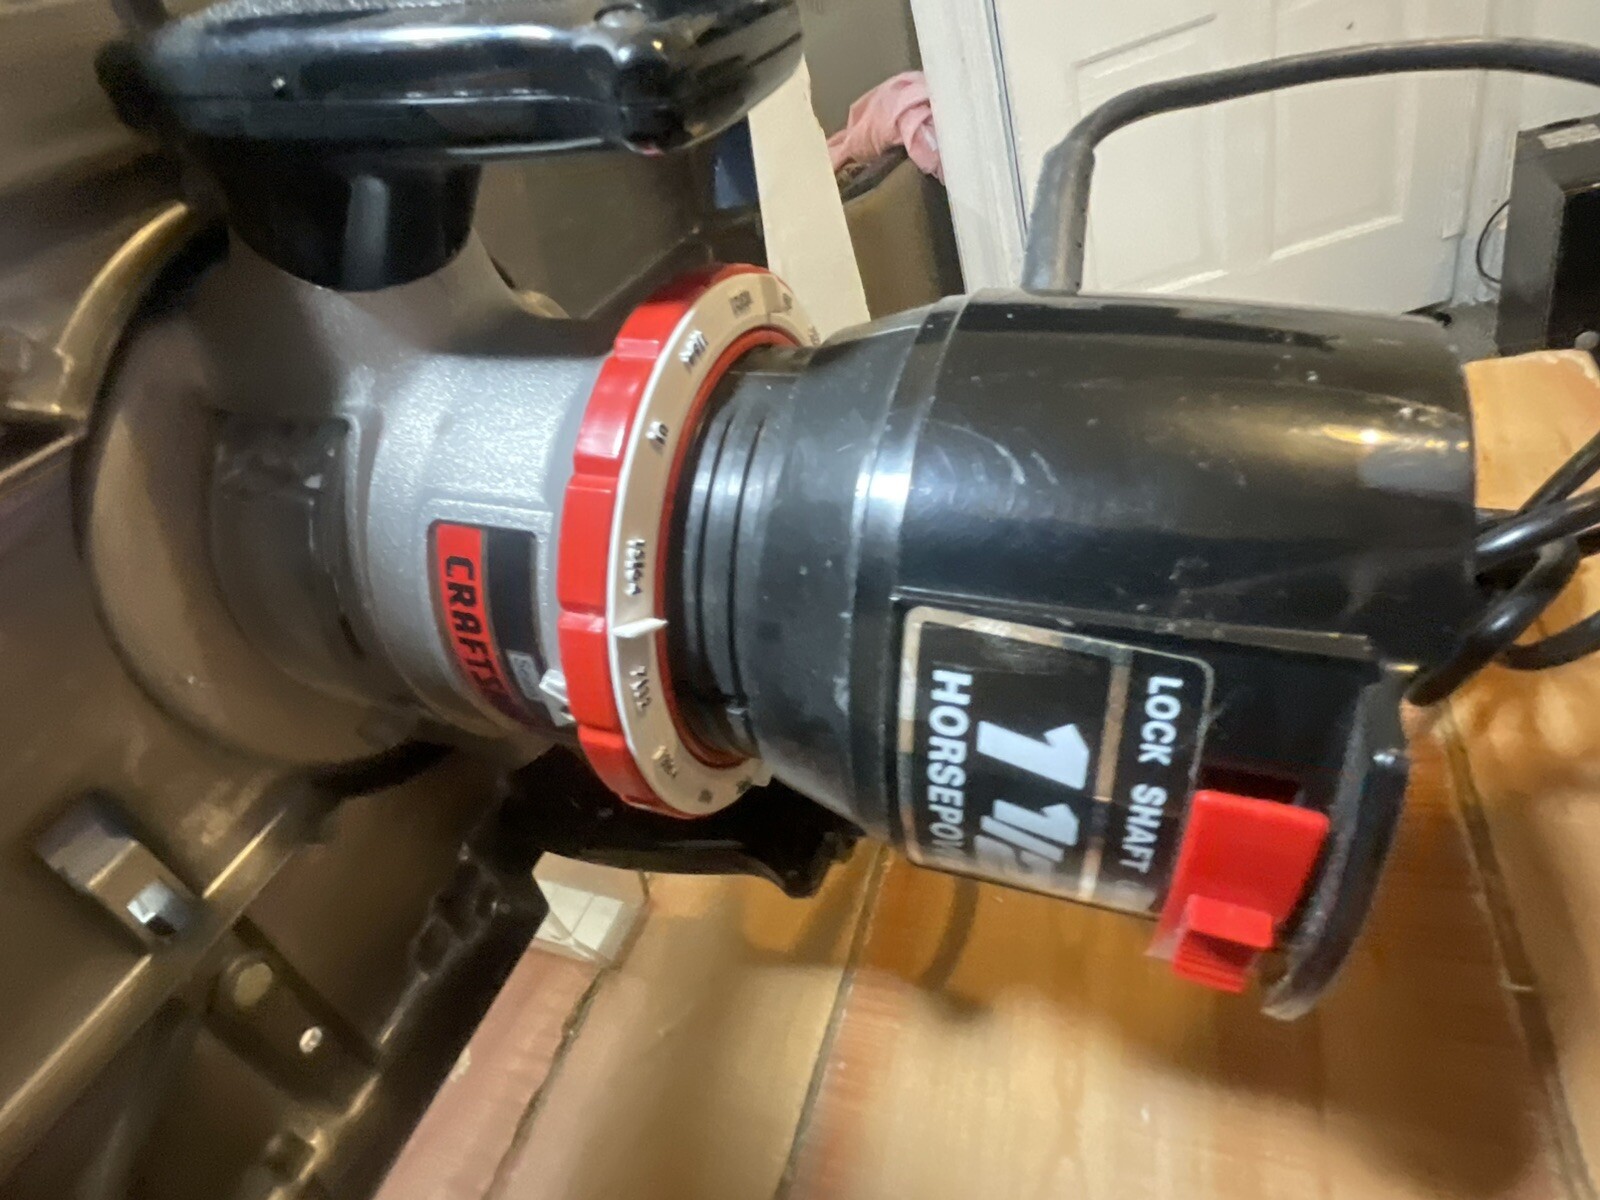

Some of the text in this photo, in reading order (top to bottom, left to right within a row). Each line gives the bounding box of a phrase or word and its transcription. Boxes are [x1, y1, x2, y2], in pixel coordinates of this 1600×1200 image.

[976, 720, 1090, 790] 1
[1119, 675, 1185, 873] LOCK SHAFT
